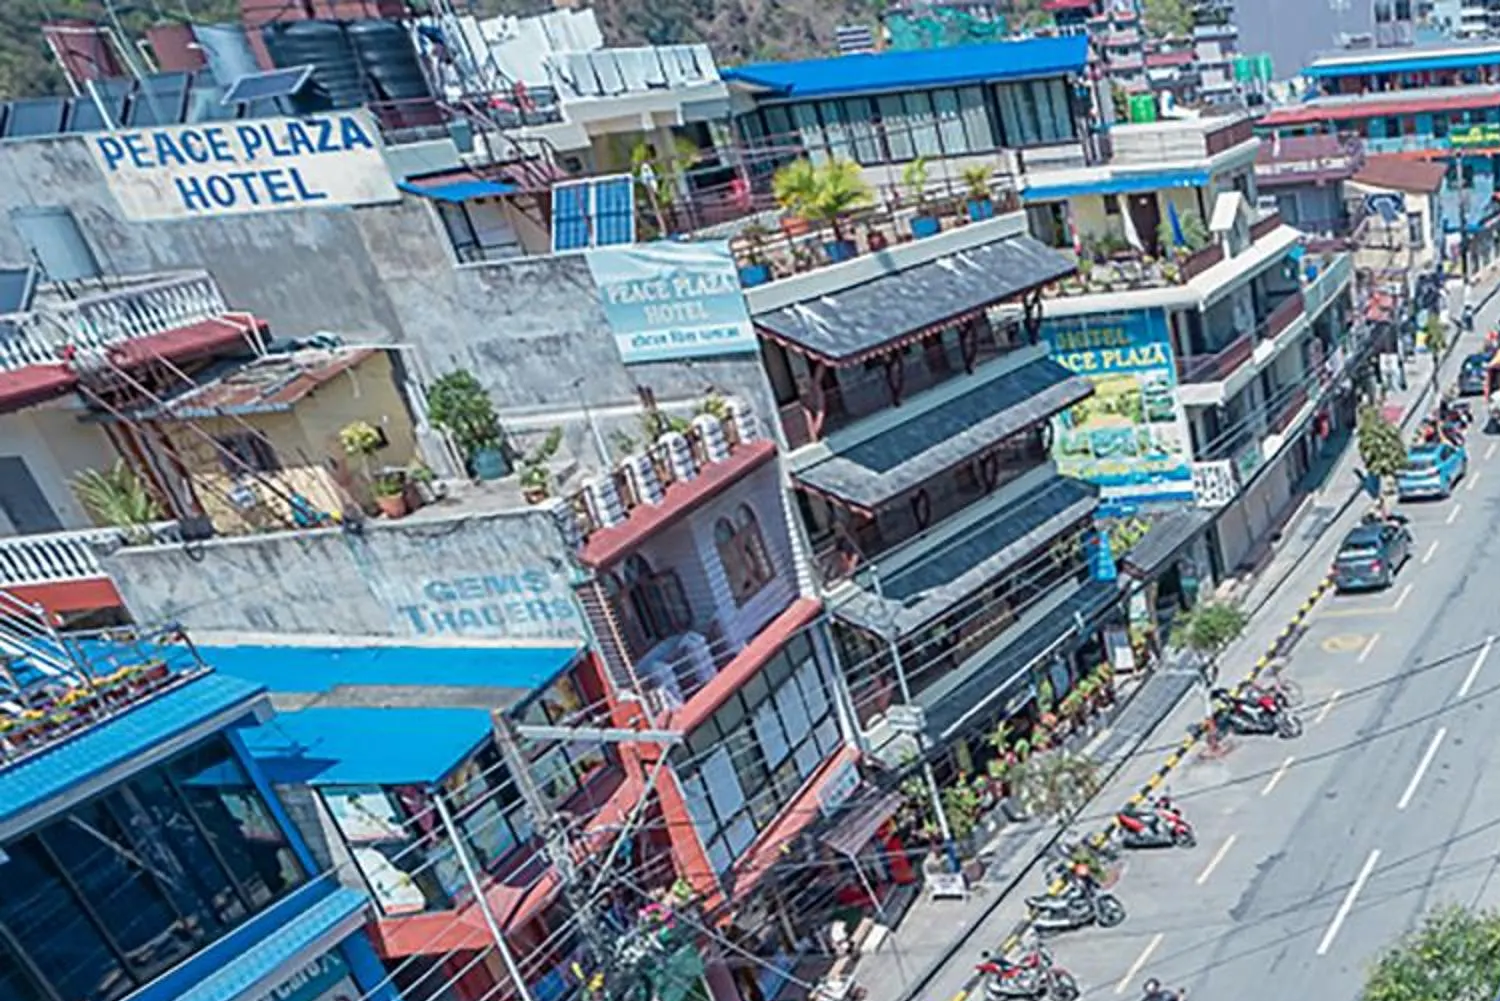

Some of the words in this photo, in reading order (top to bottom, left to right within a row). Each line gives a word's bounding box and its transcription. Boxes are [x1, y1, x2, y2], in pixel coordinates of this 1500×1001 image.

[96, 127, 236, 171] PEACE
[236, 115, 373, 161] PLAZA
[174, 166, 328, 211] HOTEL
[606, 280, 670, 305] PEACE
[672, 273, 738, 298] PLAZA
[643, 300, 711, 325] HOTEL
[1056, 327, 1131, 349] HOTEL
[1101, 342, 1170, 369] PLAZA
[424, 568, 549, 602] GEMS
